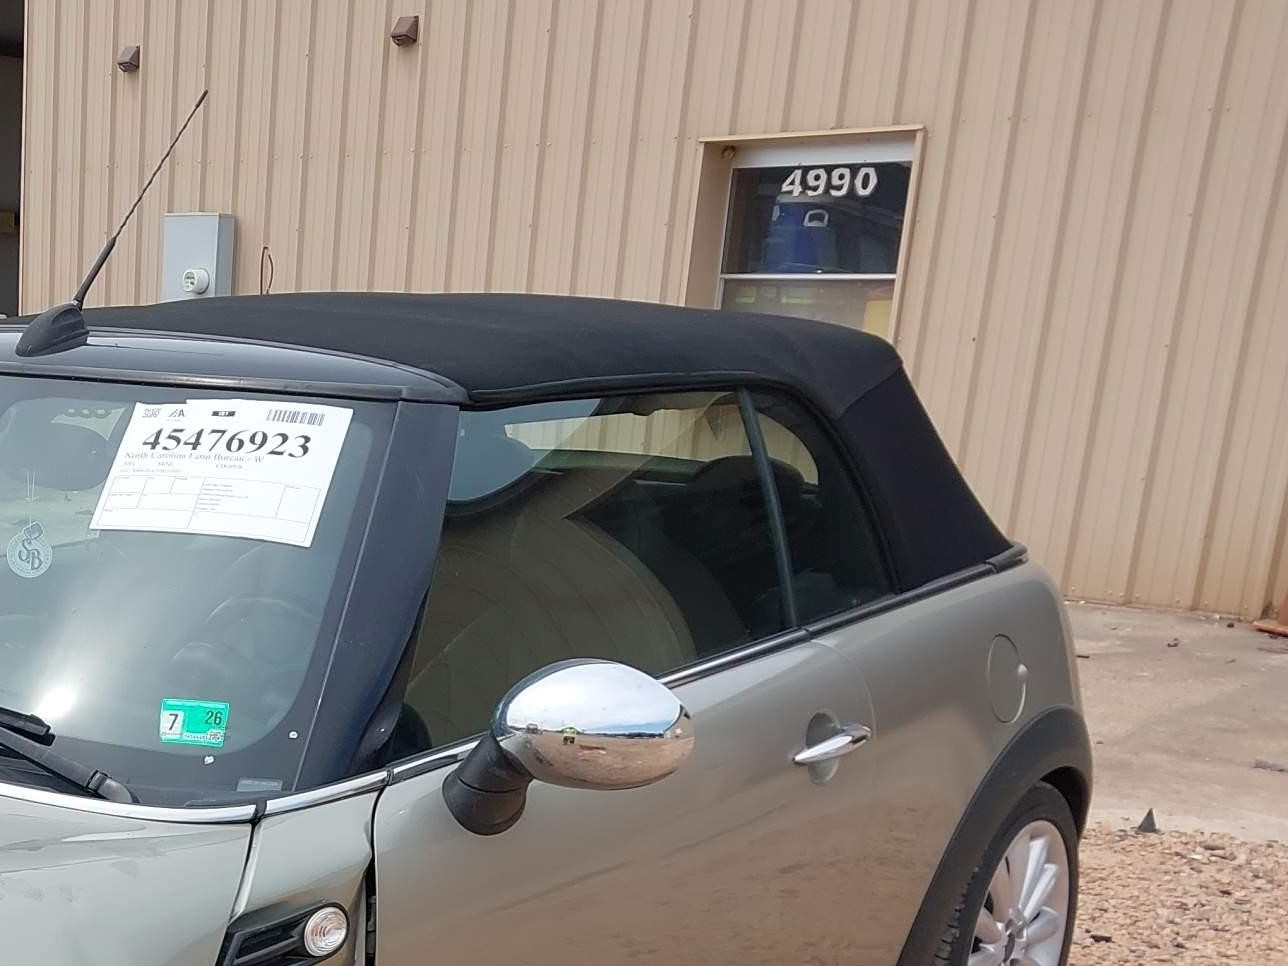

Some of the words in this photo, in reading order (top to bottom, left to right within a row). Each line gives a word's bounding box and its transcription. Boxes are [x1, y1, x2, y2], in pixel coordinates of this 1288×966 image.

[781, 167, 878, 197] 4990
[142, 427, 312, 459] 45476923
[124, 452, 149, 460] North
[151, 452, 186, 460] Carolina
[168, 713, 179, 731] 7
[205, 710, 223, 726] 26
